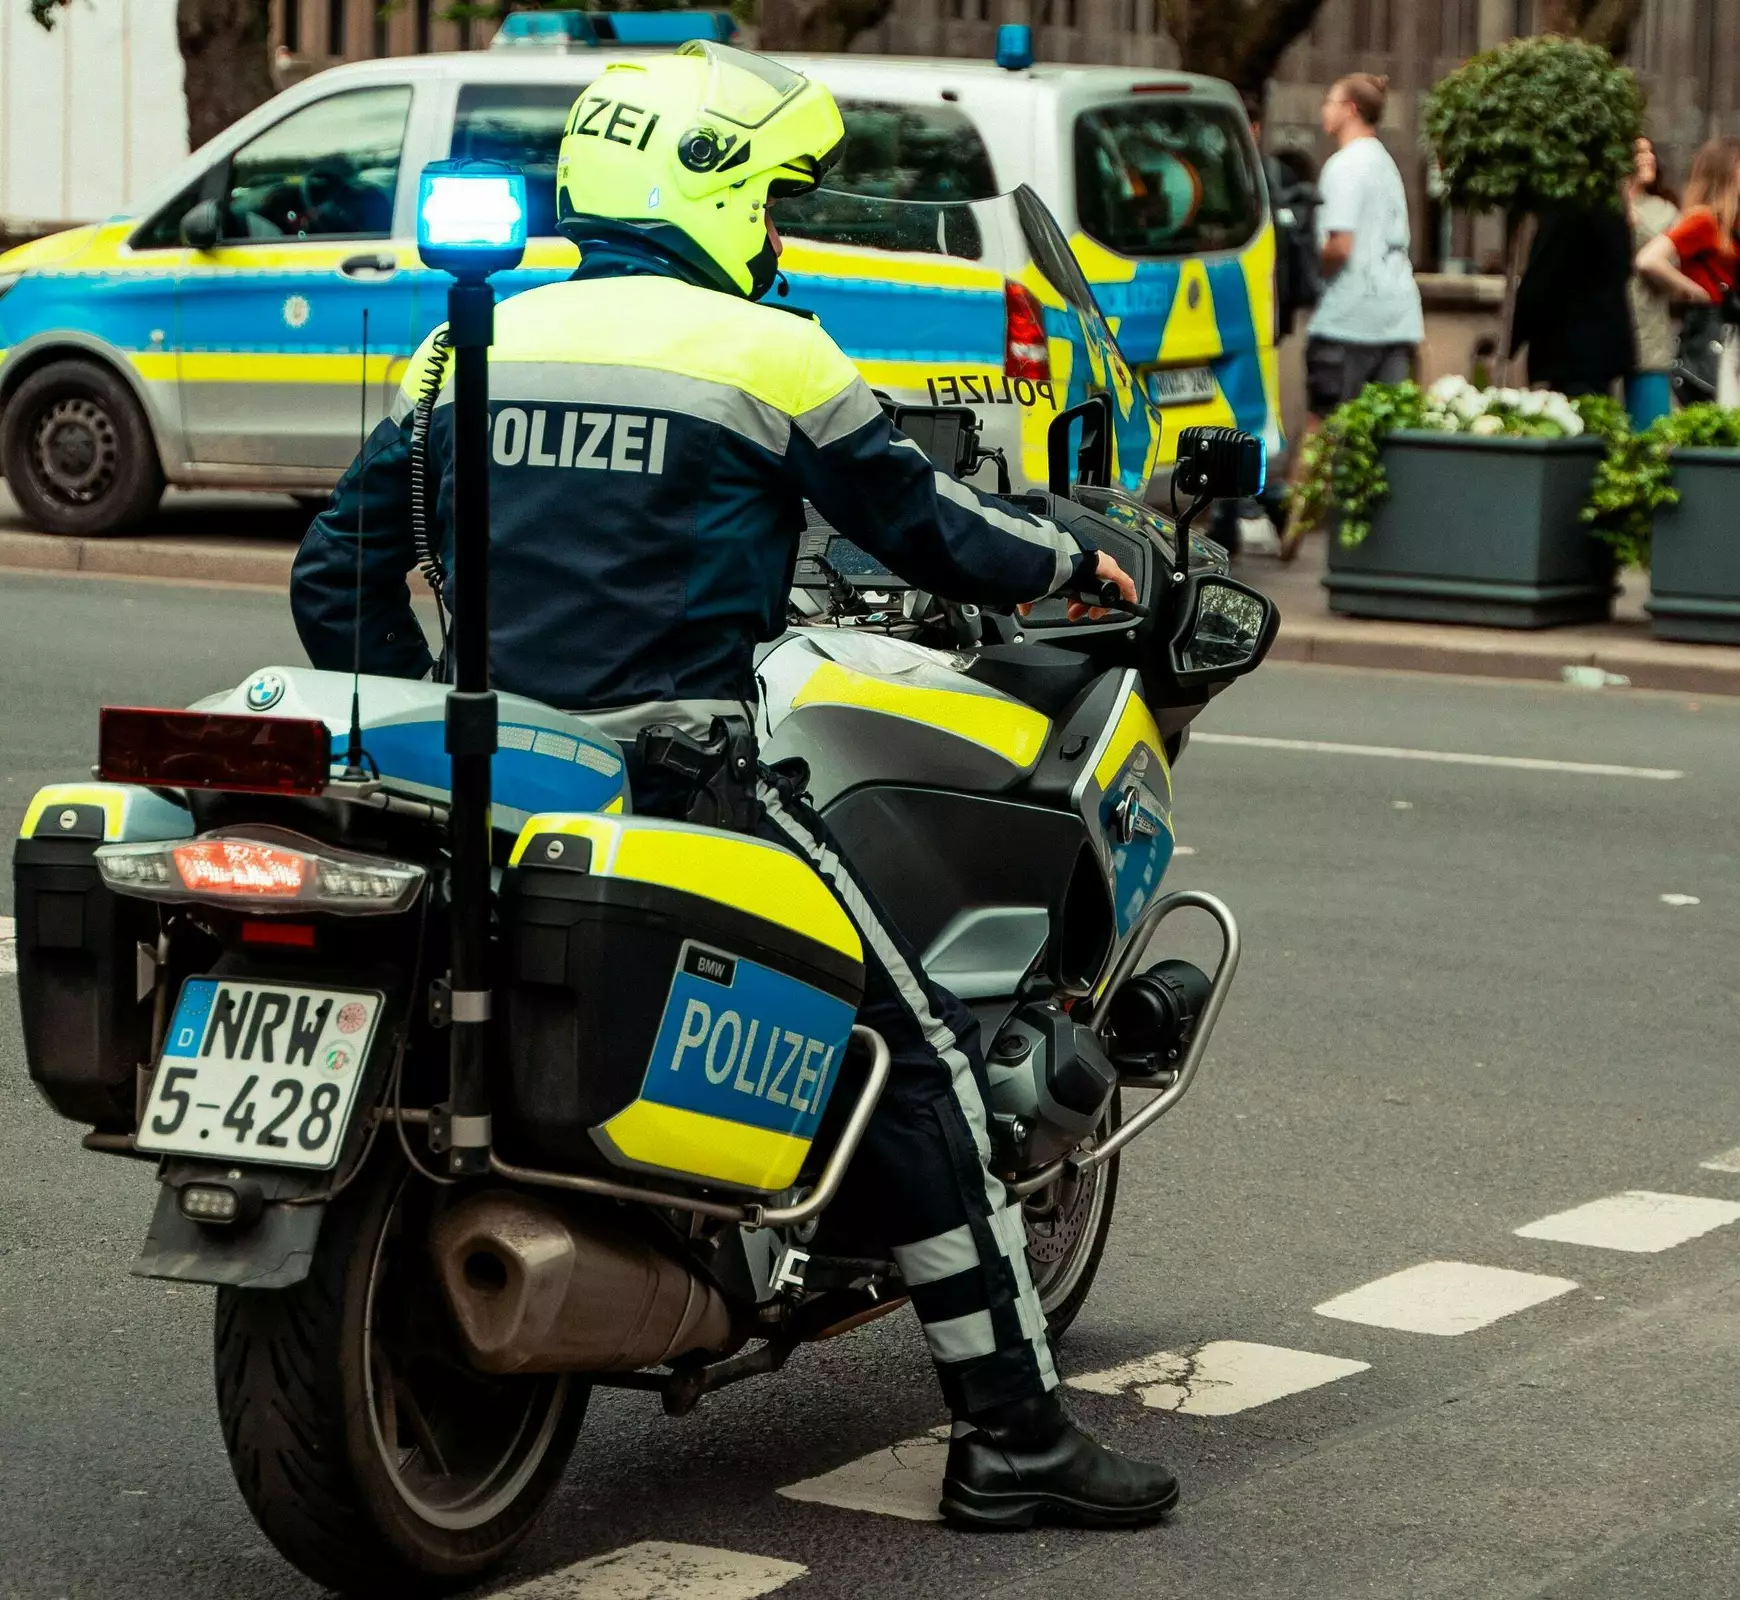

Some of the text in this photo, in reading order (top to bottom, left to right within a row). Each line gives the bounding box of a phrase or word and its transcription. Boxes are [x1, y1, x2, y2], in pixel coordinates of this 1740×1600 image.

[562, 97, 660, 151] IZEI
[487, 407, 668, 474] OLIZEI
[697, 957, 725, 978] BMW
[177, 1028, 194, 1047] D
[201, 988, 334, 1066] NRW
[670, 998, 835, 1115] POLIZEI
[152, 1067, 340, 1150] 5-428
